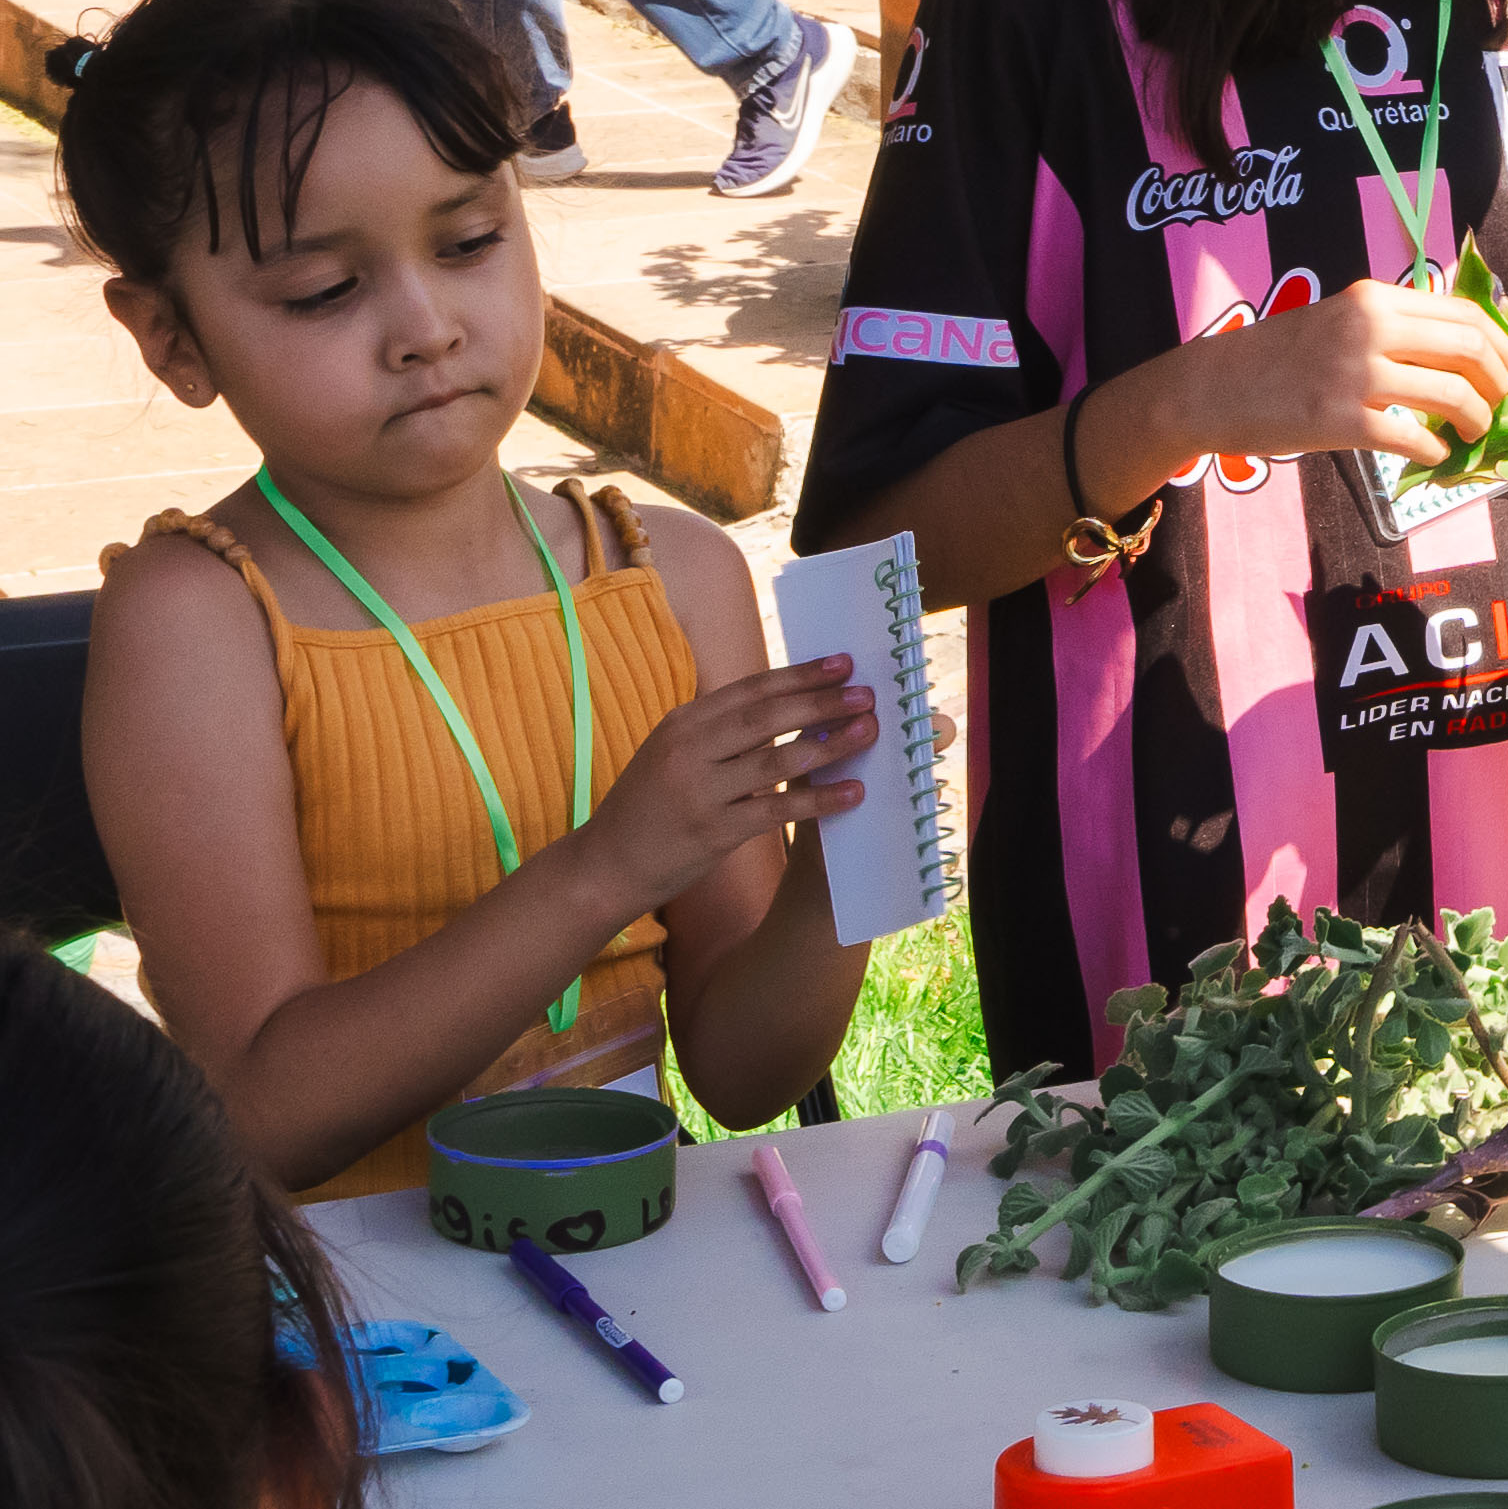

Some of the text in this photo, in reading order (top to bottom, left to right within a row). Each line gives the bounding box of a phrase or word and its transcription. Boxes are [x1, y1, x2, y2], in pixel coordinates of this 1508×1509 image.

[1318, 100, 1450, 131] Qurétaro
[1340, 695, 1430, 731] LIDER
[1389, 720, 1435, 741] EN
